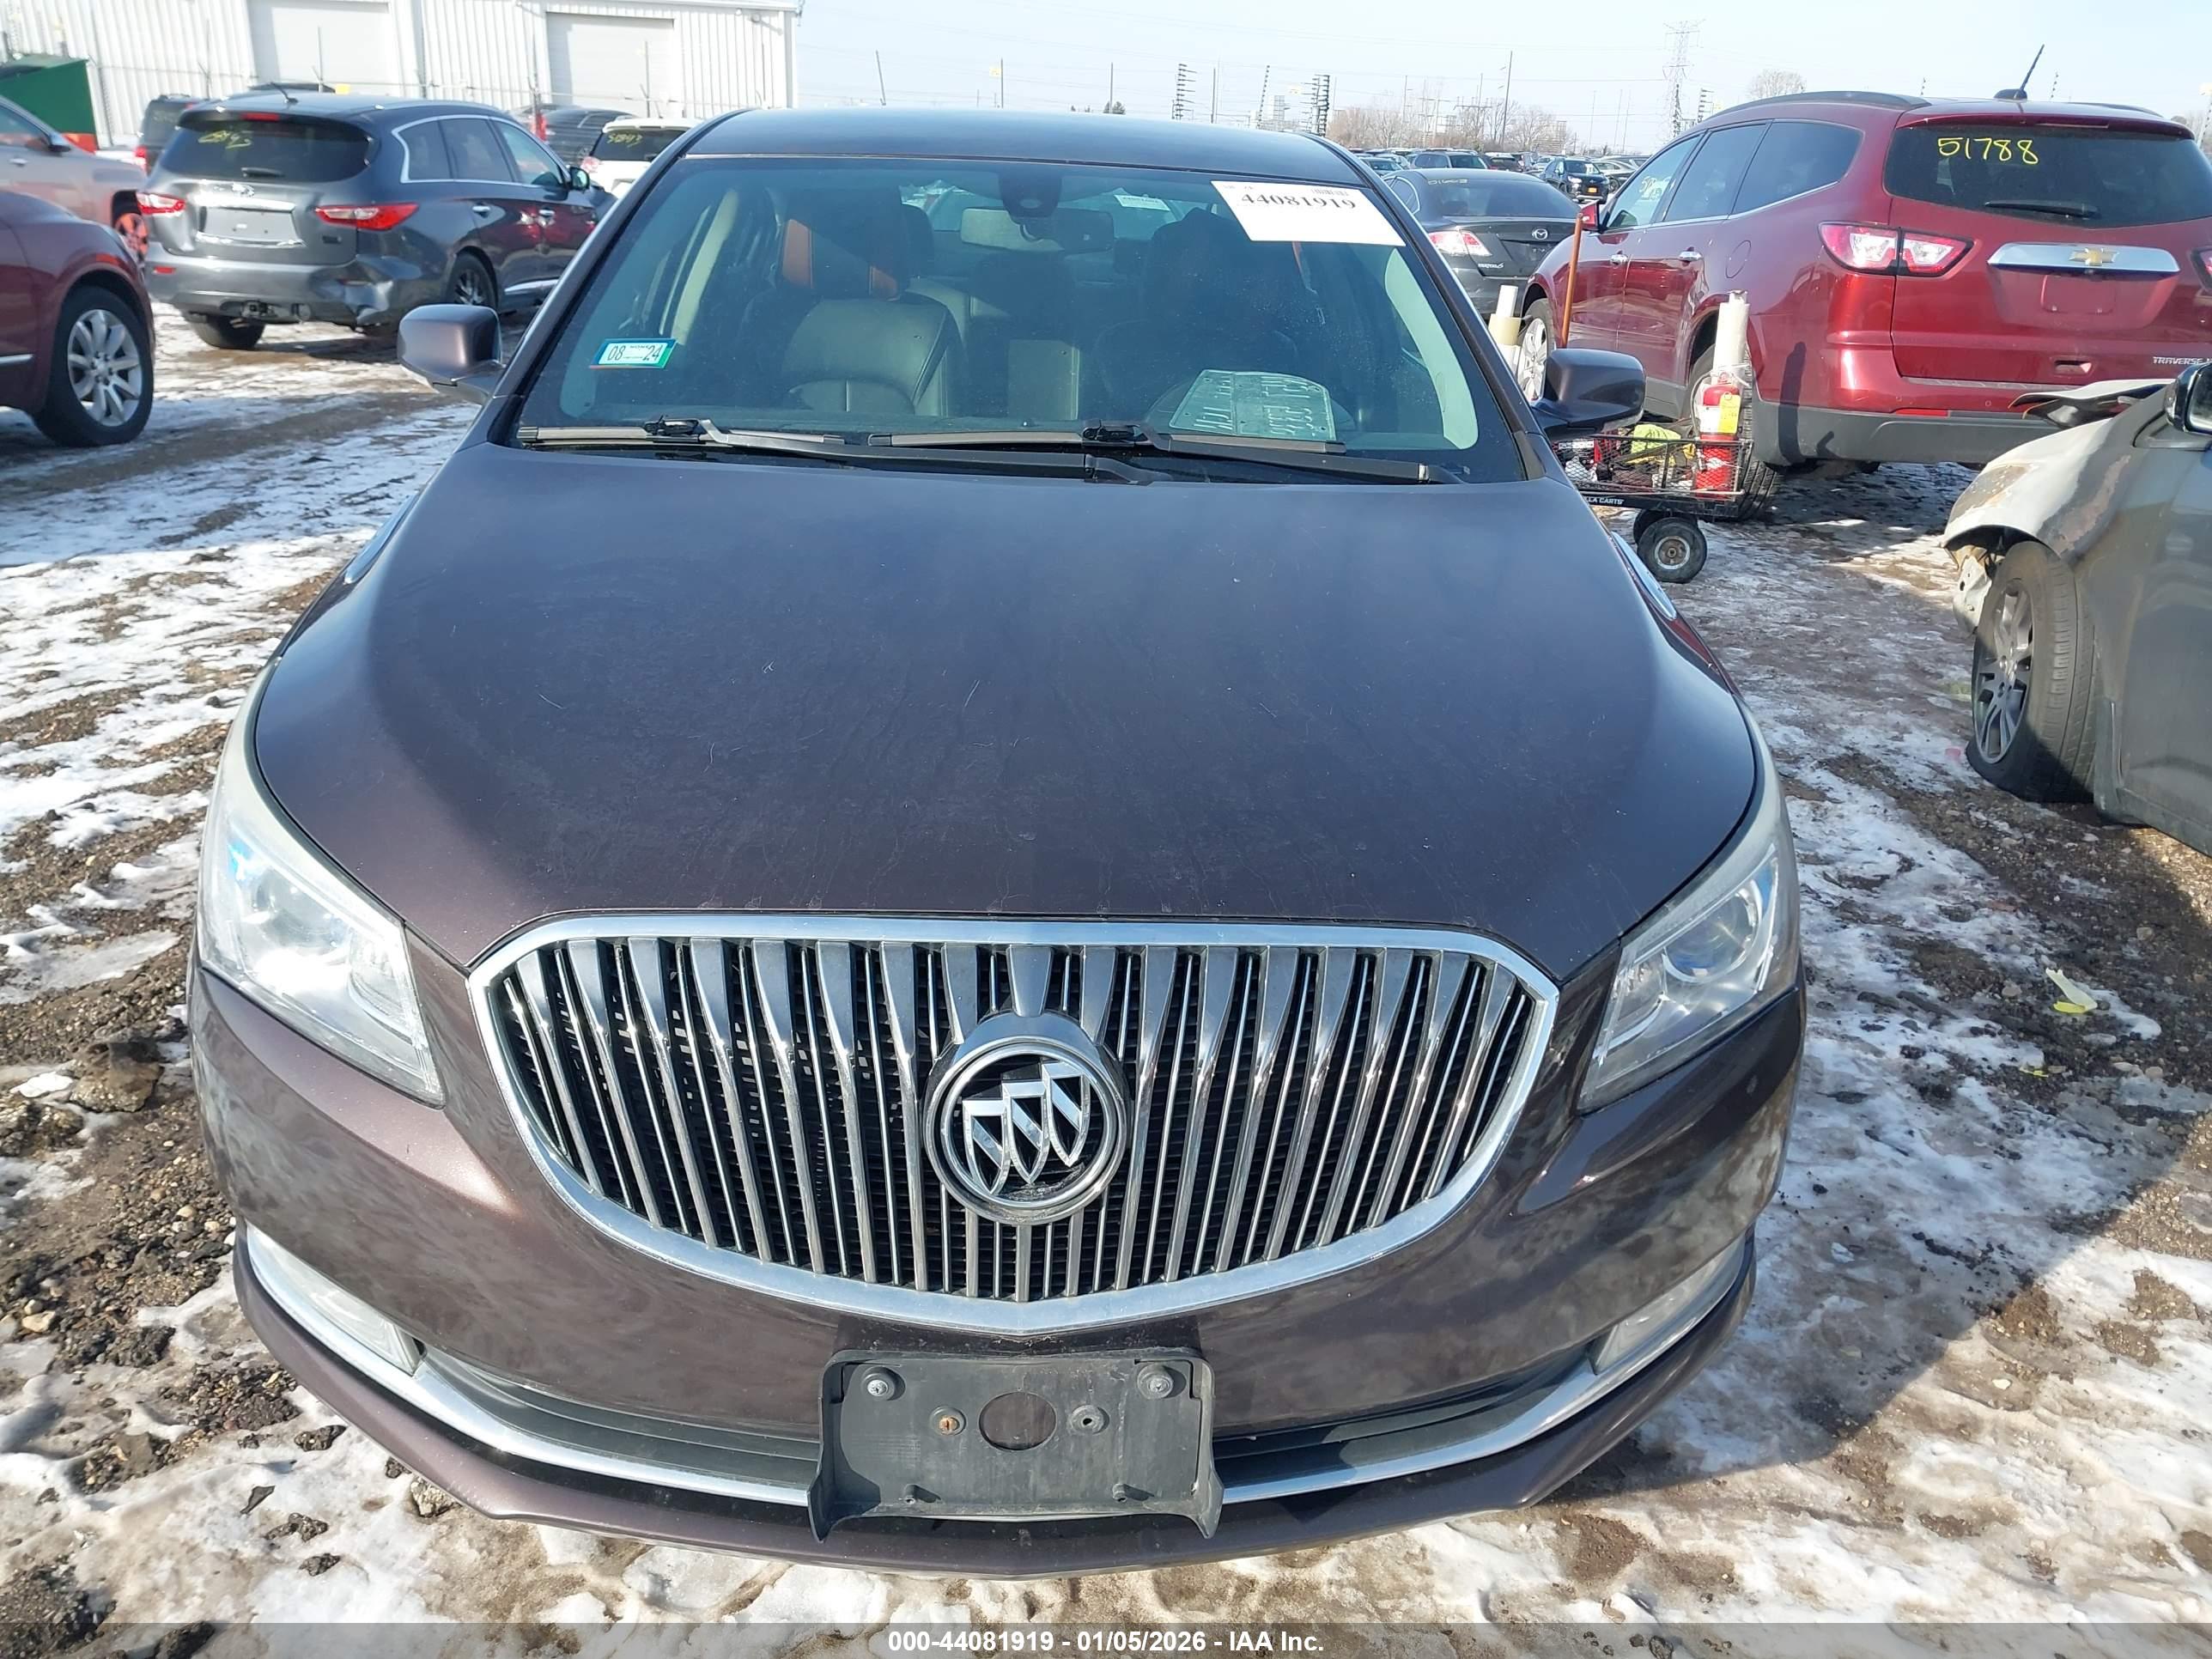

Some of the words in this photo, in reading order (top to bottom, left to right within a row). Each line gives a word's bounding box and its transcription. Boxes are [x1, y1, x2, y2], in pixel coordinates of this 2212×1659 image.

[1937, 137, 2039, 165] 51788
[1241, 193, 1357, 210] 44081919
[606, 344, 627, 362] 08
[641, 343, 664, 362] 24
[2152, 356, 2203, 365] TRAVERSE
